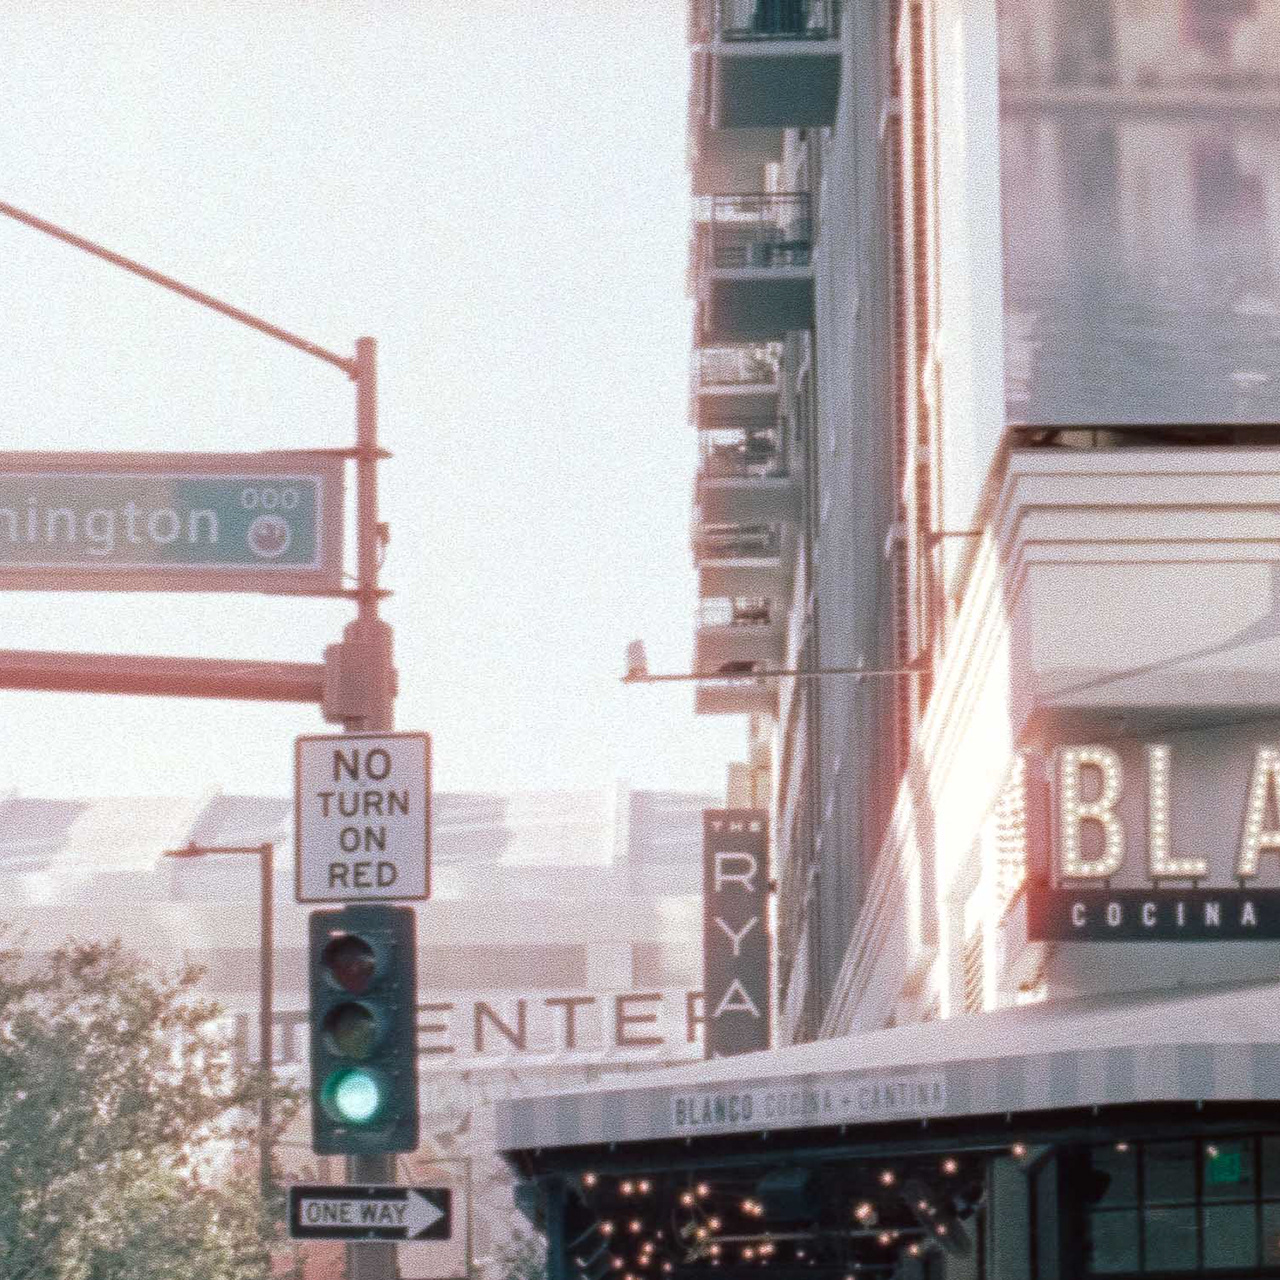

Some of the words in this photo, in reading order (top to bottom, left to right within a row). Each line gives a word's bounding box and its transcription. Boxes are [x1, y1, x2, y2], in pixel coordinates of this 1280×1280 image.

[332, 748, 393, 782] NO
[316, 789, 411, 818] TURN
[339, 825, 387, 853] ON
[328, 860, 399, 888] RED
[1071, 901, 1260, 927] COCINA
[713, 851, 761, 1018] RYA
[675, 1092, 754, 1126] BLANCO
[306, 1202, 353, 1224] ONE
[360, 1203, 408, 1224] WAY
